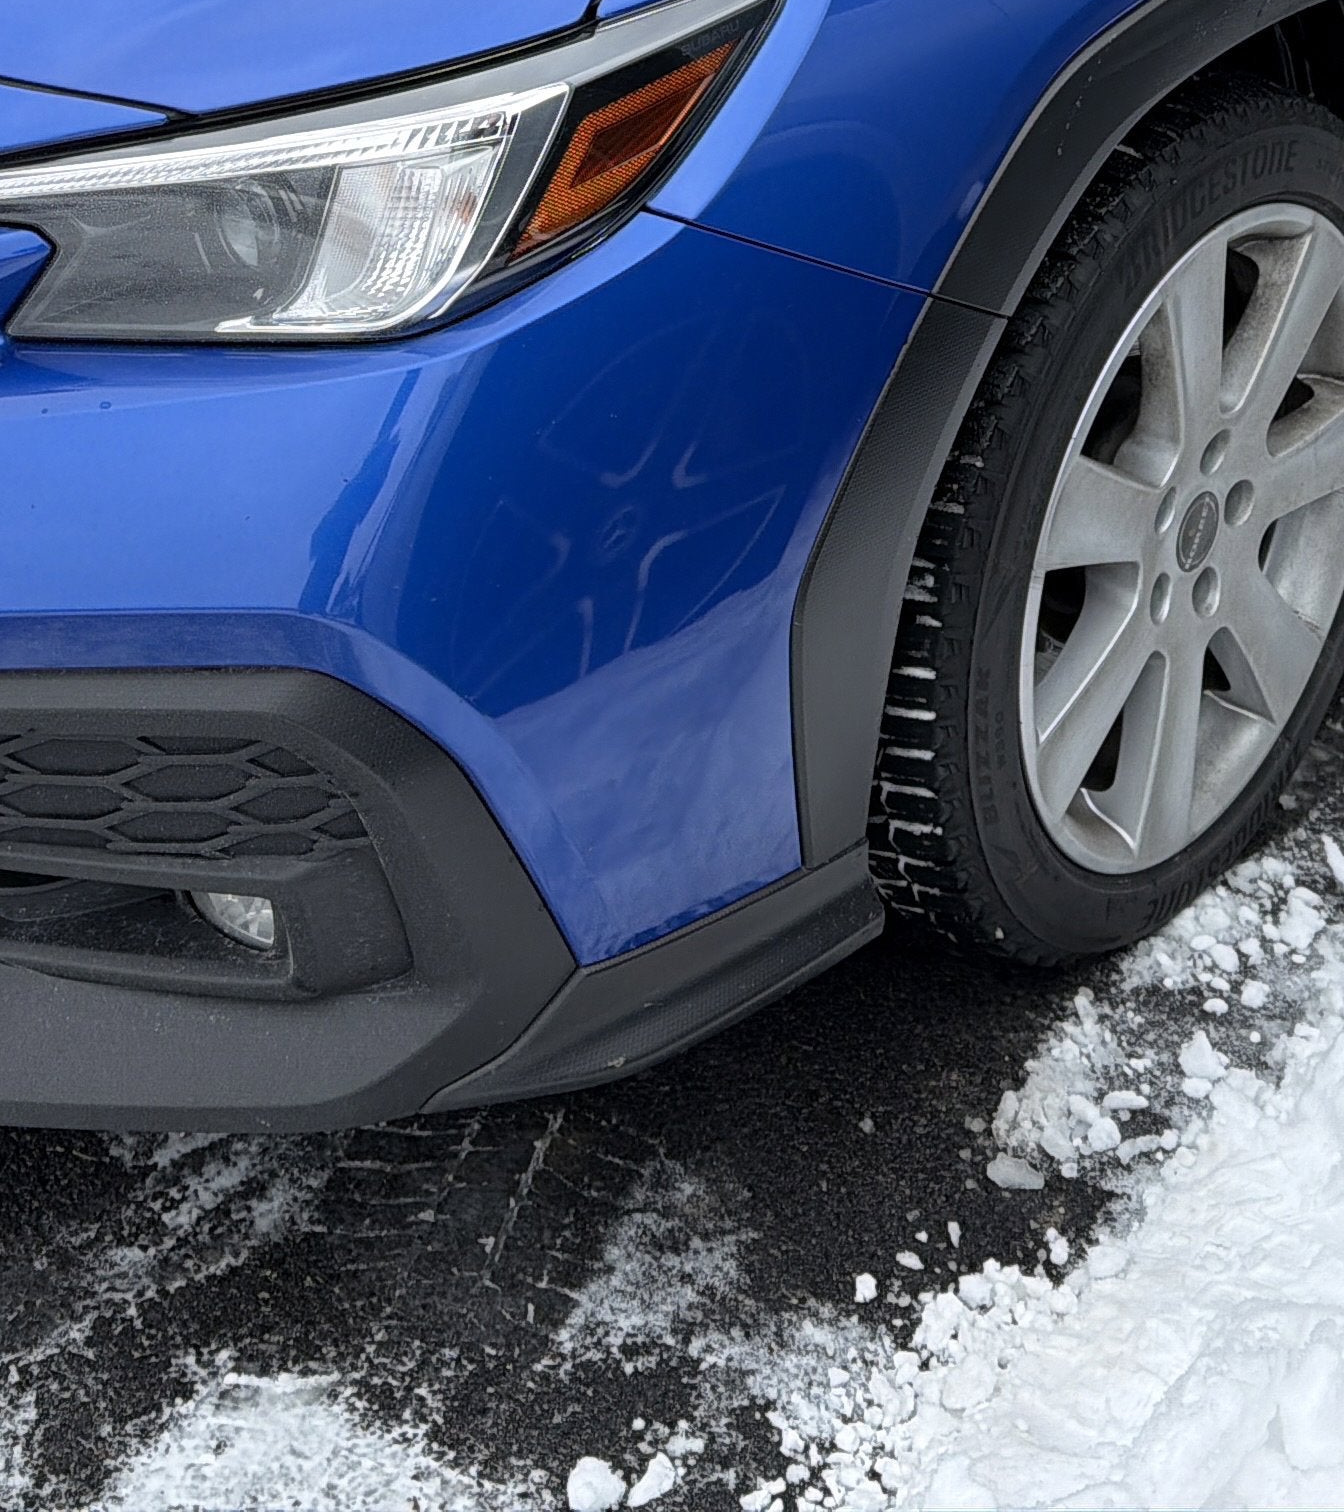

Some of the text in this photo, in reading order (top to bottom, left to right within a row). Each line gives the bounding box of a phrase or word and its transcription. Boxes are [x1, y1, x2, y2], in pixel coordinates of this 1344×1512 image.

[680, 19, 740, 56] SUBARU
[1116, 139, 1299, 299] BRIDGESTONE
[975, 666, 1000, 826] BLIZZAK
